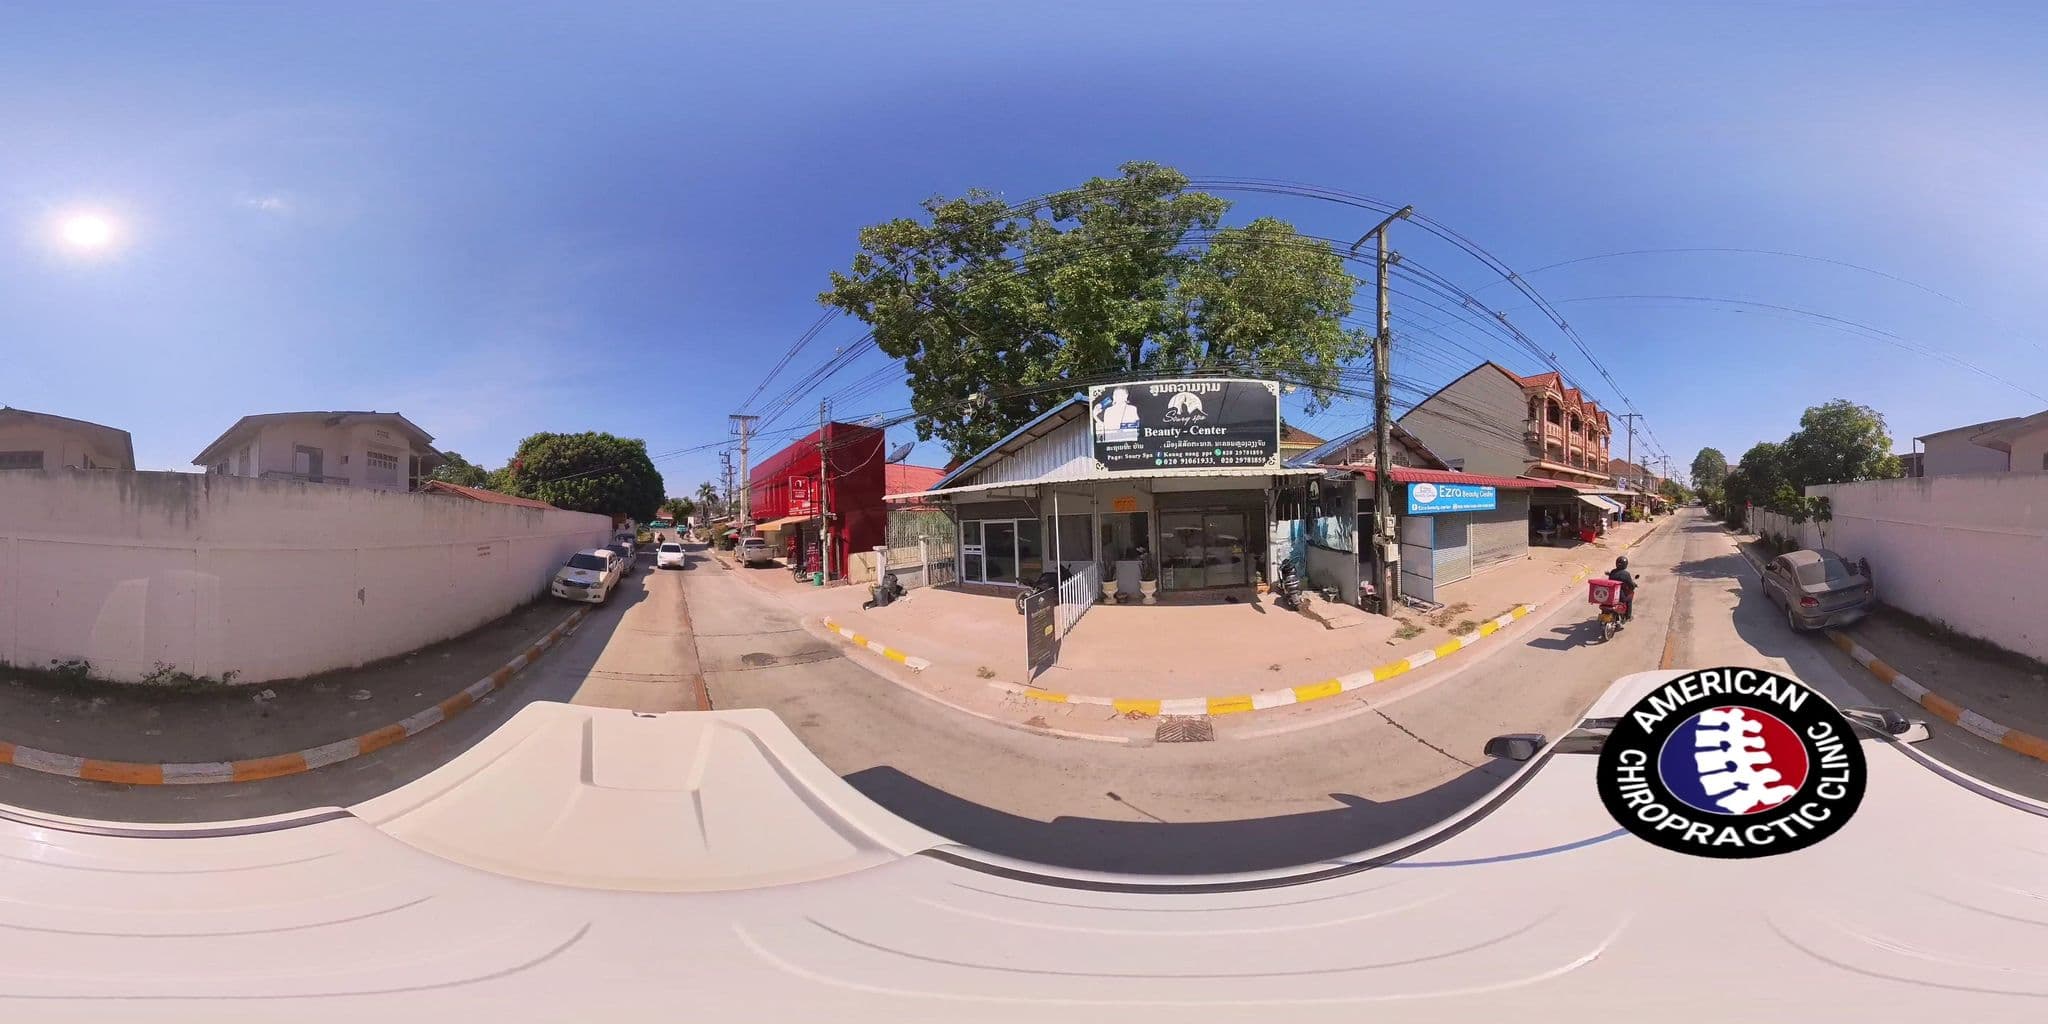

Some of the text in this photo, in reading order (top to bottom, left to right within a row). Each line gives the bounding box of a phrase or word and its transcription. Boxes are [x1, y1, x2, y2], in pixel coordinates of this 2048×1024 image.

[1144, 427, 1181, 438] Beauty
[1189, 425, 1227, 435] Center
[1439, 485, 1462, 498] Ezra
